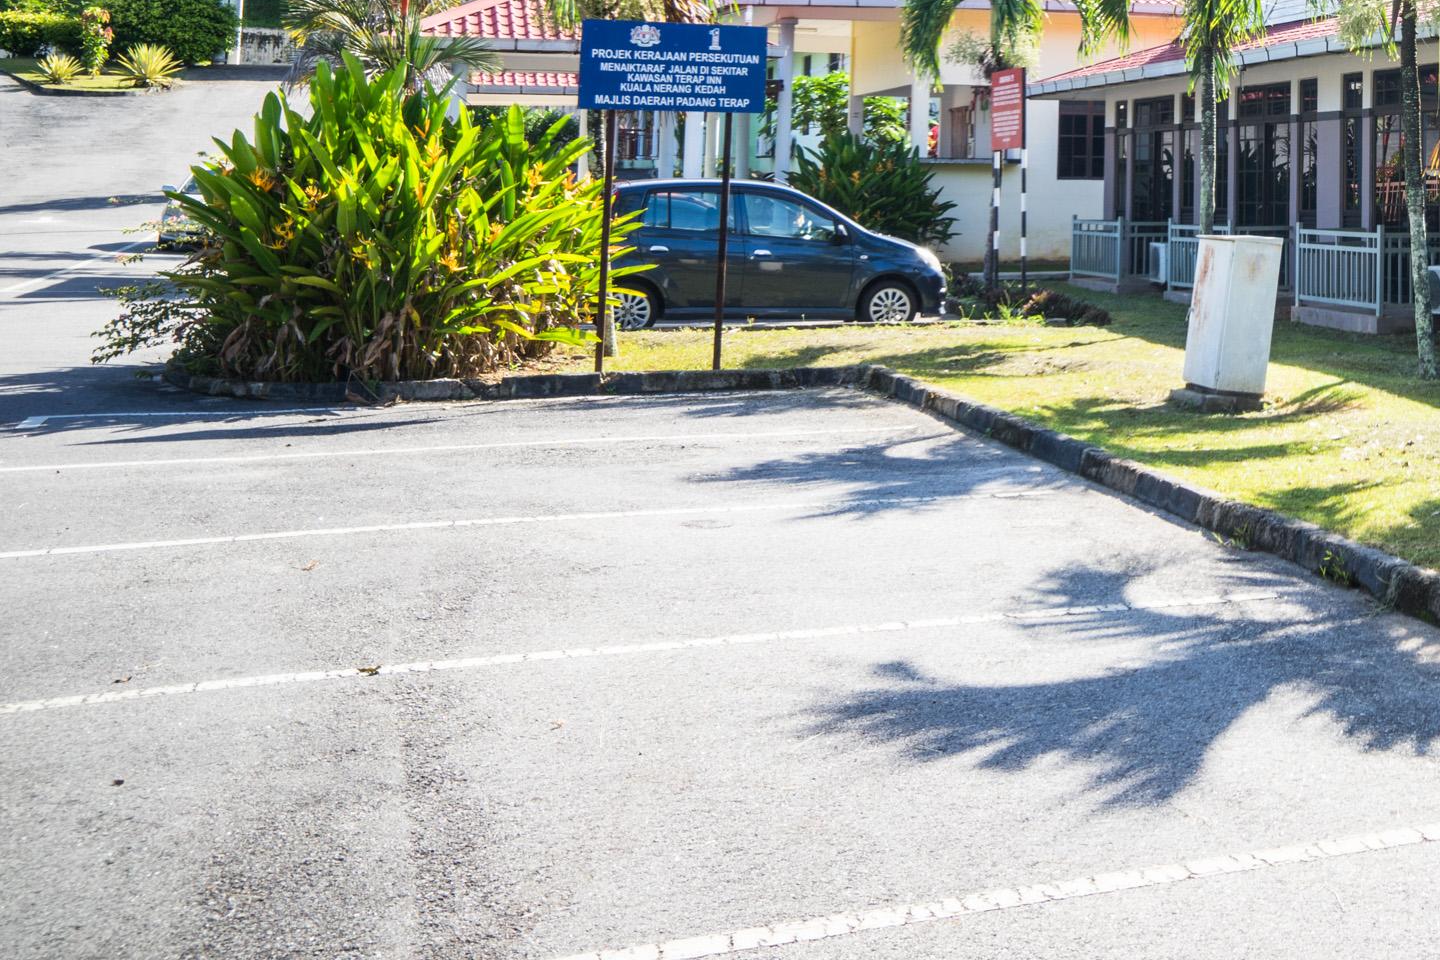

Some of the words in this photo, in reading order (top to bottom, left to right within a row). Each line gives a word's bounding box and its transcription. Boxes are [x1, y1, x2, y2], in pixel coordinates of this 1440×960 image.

[592, 49, 632, 60] PROJEK
[634, 50, 687, 62] KERAJAAN
[689, 53, 760, 64] PERSEKUTUAN
[600, 62, 665, 73] MENAIKTARAF
[669, 65, 697, 74] JALAN
[700, 66, 709, 74] DI
[711, 66, 748, 75] SEKITAR
[627, 74, 672, 83] KAWASAN
[676, 75, 705, 84] TERAP
[706, 76, 722, 84] INN
[620, 82, 652, 92] KUALA
[653, 84, 692, 93] NERANG
[695, 85, 726, 94] KEDAH
[595, 95, 631, 104] MAJLIS
[632, 96, 674, 106] DAERAH
[676, 97, 716, 107] PADANG
[719, 98, 750, 108] TERAP
